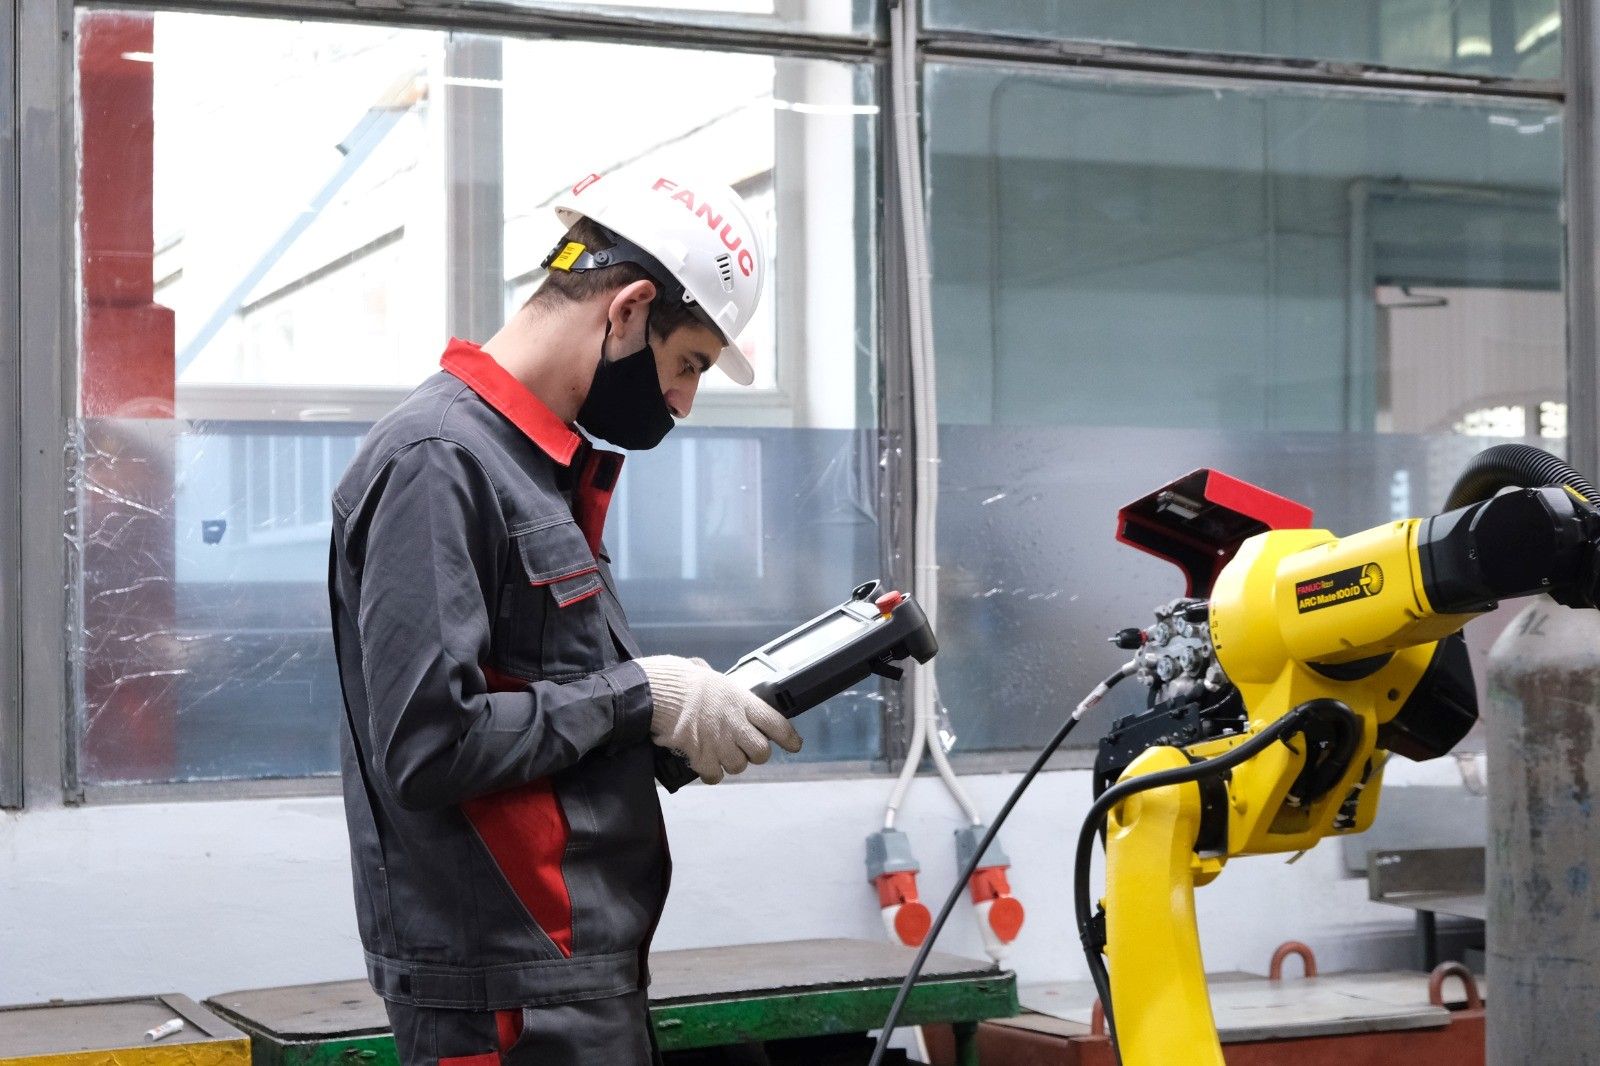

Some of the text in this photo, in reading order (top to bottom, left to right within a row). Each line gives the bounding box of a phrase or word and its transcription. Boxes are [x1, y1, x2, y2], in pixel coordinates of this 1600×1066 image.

[651, 177, 754, 277] FANUC
[1297, 582, 1321, 594] FANUC
[1299, 596, 1317, 609] ARC
